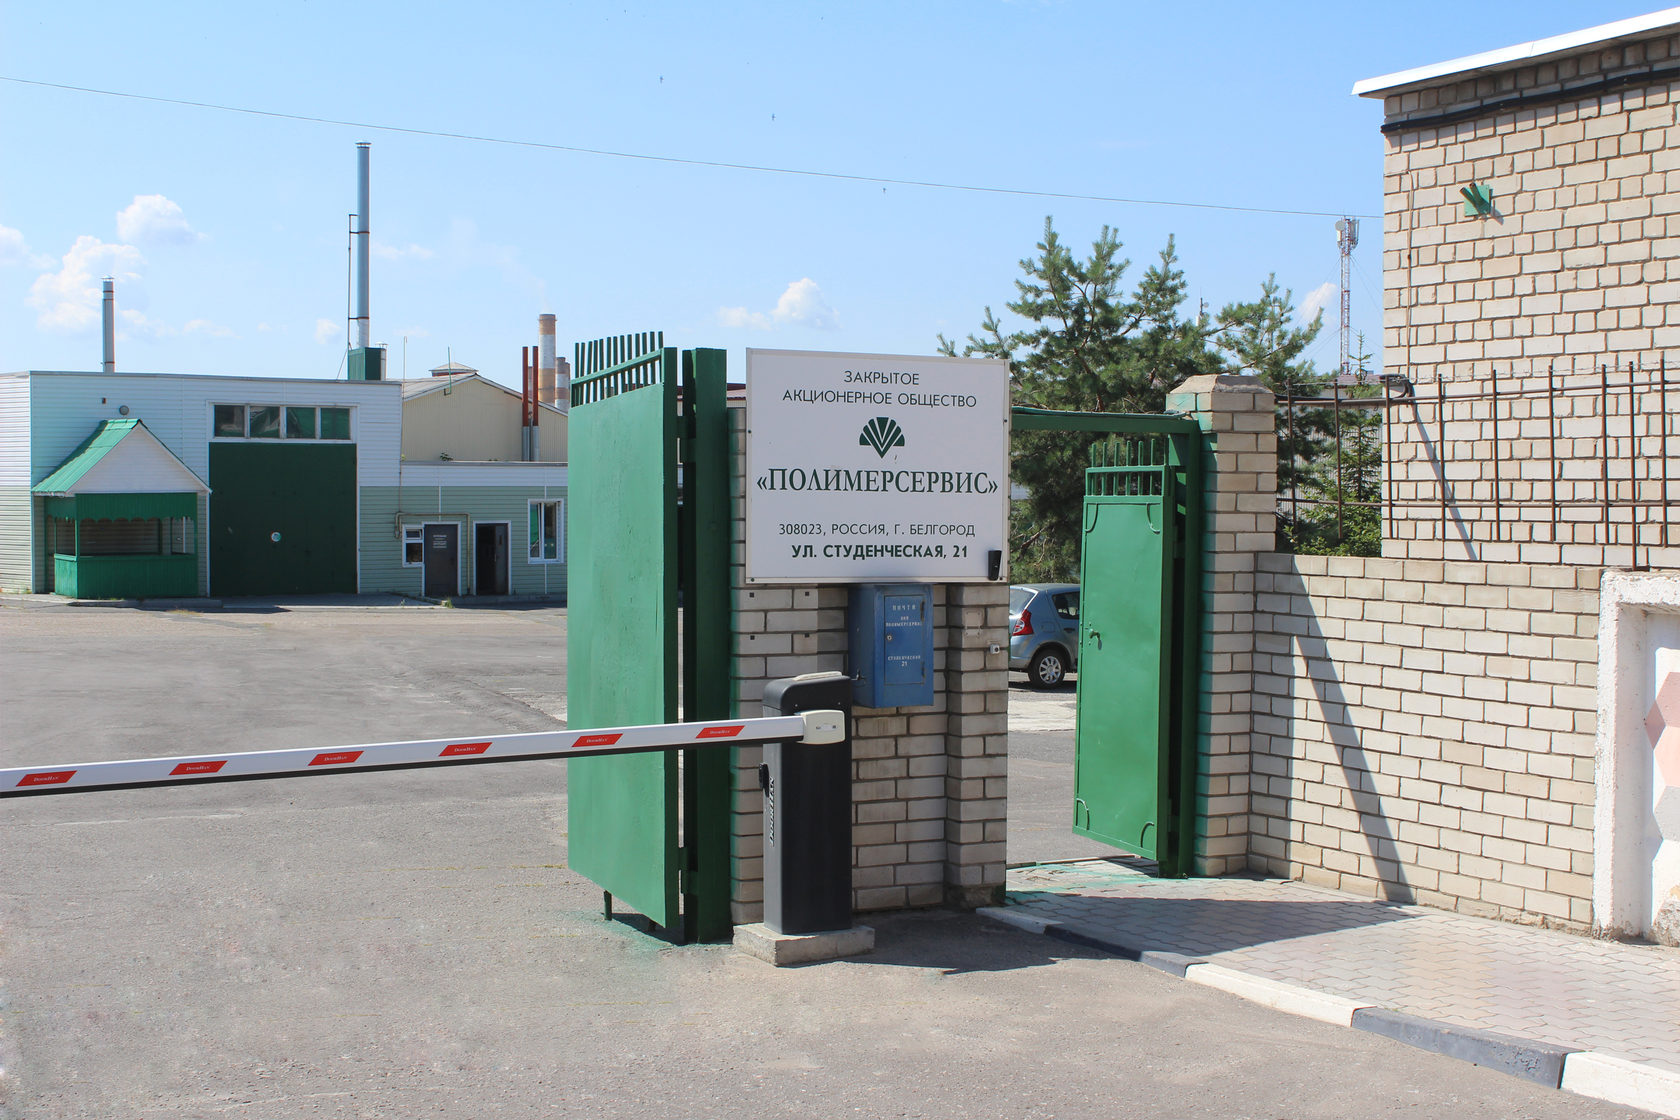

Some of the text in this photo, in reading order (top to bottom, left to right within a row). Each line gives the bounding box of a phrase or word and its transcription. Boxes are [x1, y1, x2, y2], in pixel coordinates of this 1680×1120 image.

[844, 371, 919, 385] ЗАКРЫТОЕ
[783, 389, 976, 408] АКЦИОНЕРНОЕ ОБЩЕСТВО
[757, 468, 998, 494] «ПОЛИМЕРСЕРВИС»
[779, 523, 975, 537] 308023, РОССИЯ, Г. БЕЛГОРОД
[792, 545, 967, 560] УЛ. СТУДЕНЧЕСКАЯ, 21
